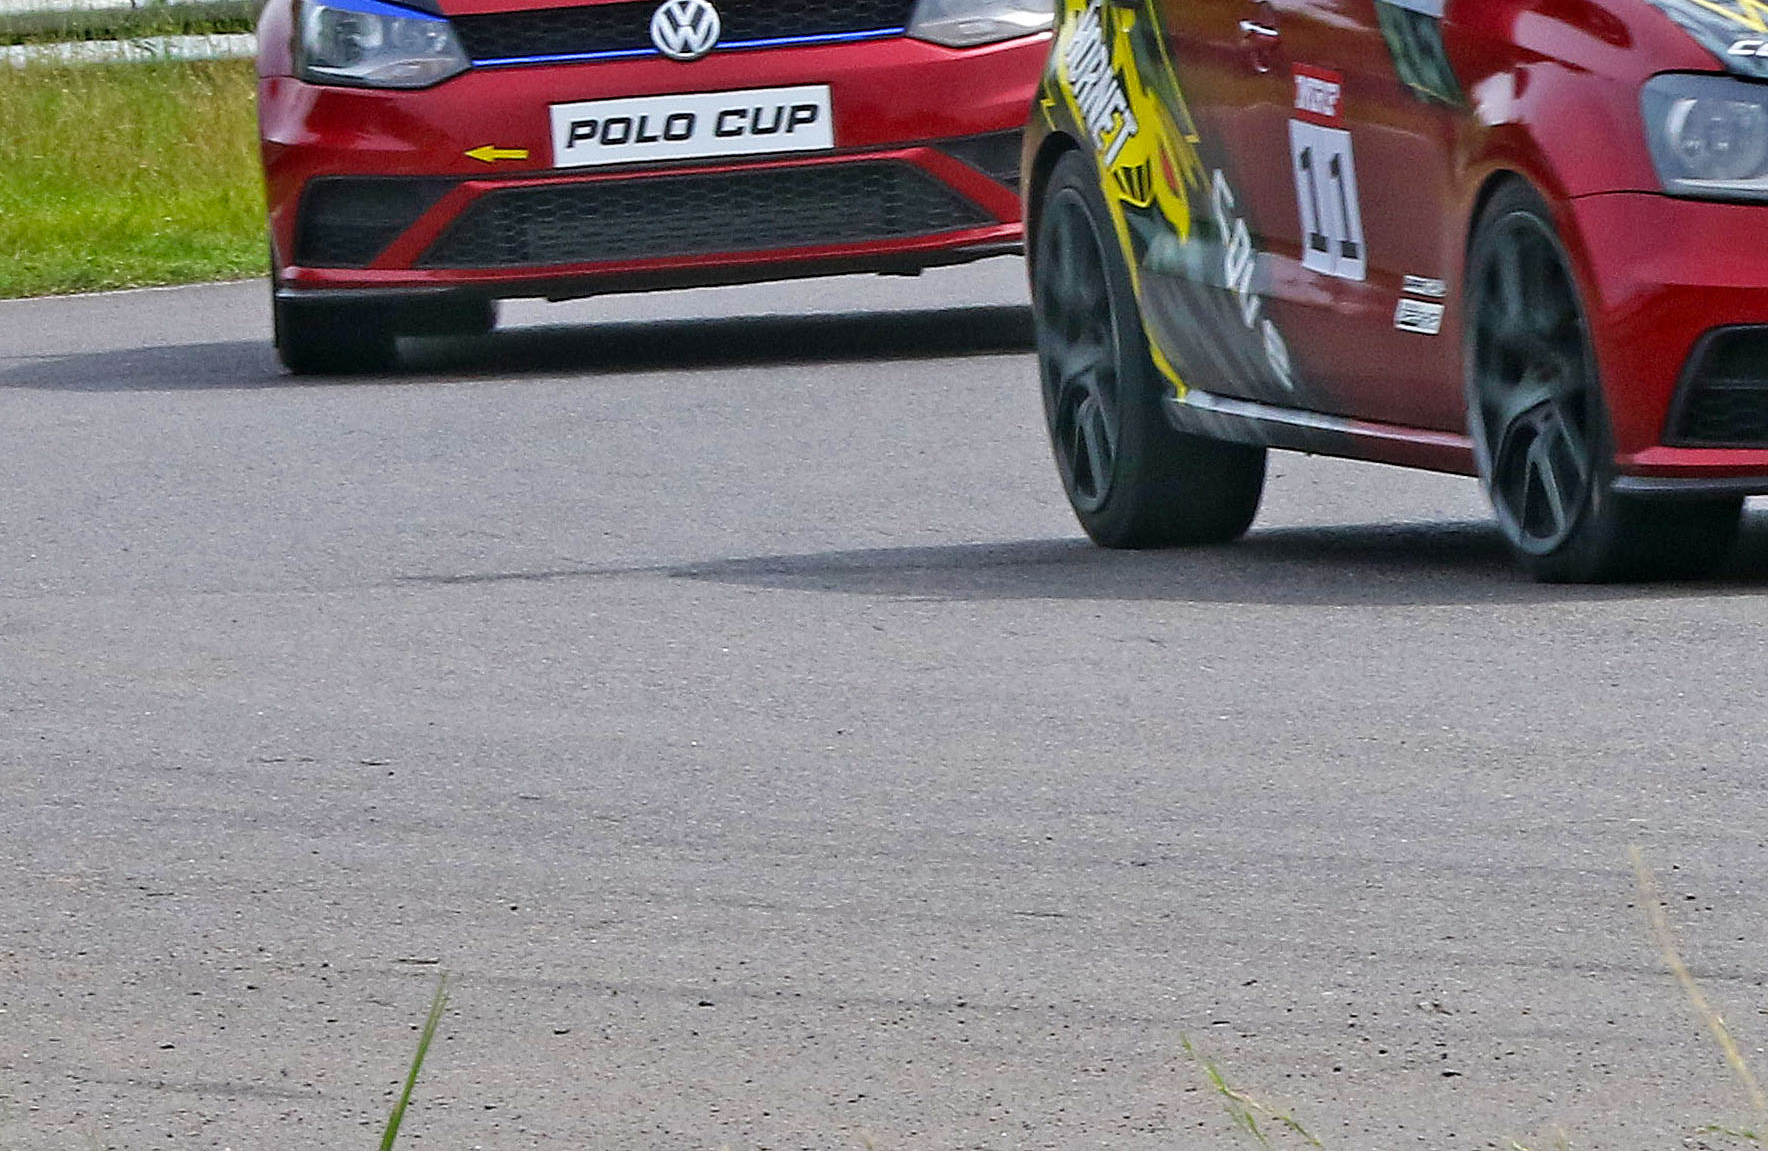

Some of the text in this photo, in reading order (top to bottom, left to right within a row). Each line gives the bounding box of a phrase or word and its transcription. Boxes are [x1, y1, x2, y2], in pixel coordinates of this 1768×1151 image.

[565, 103, 818, 149] POLO CUP
[1300, 147, 1358, 260] 11
